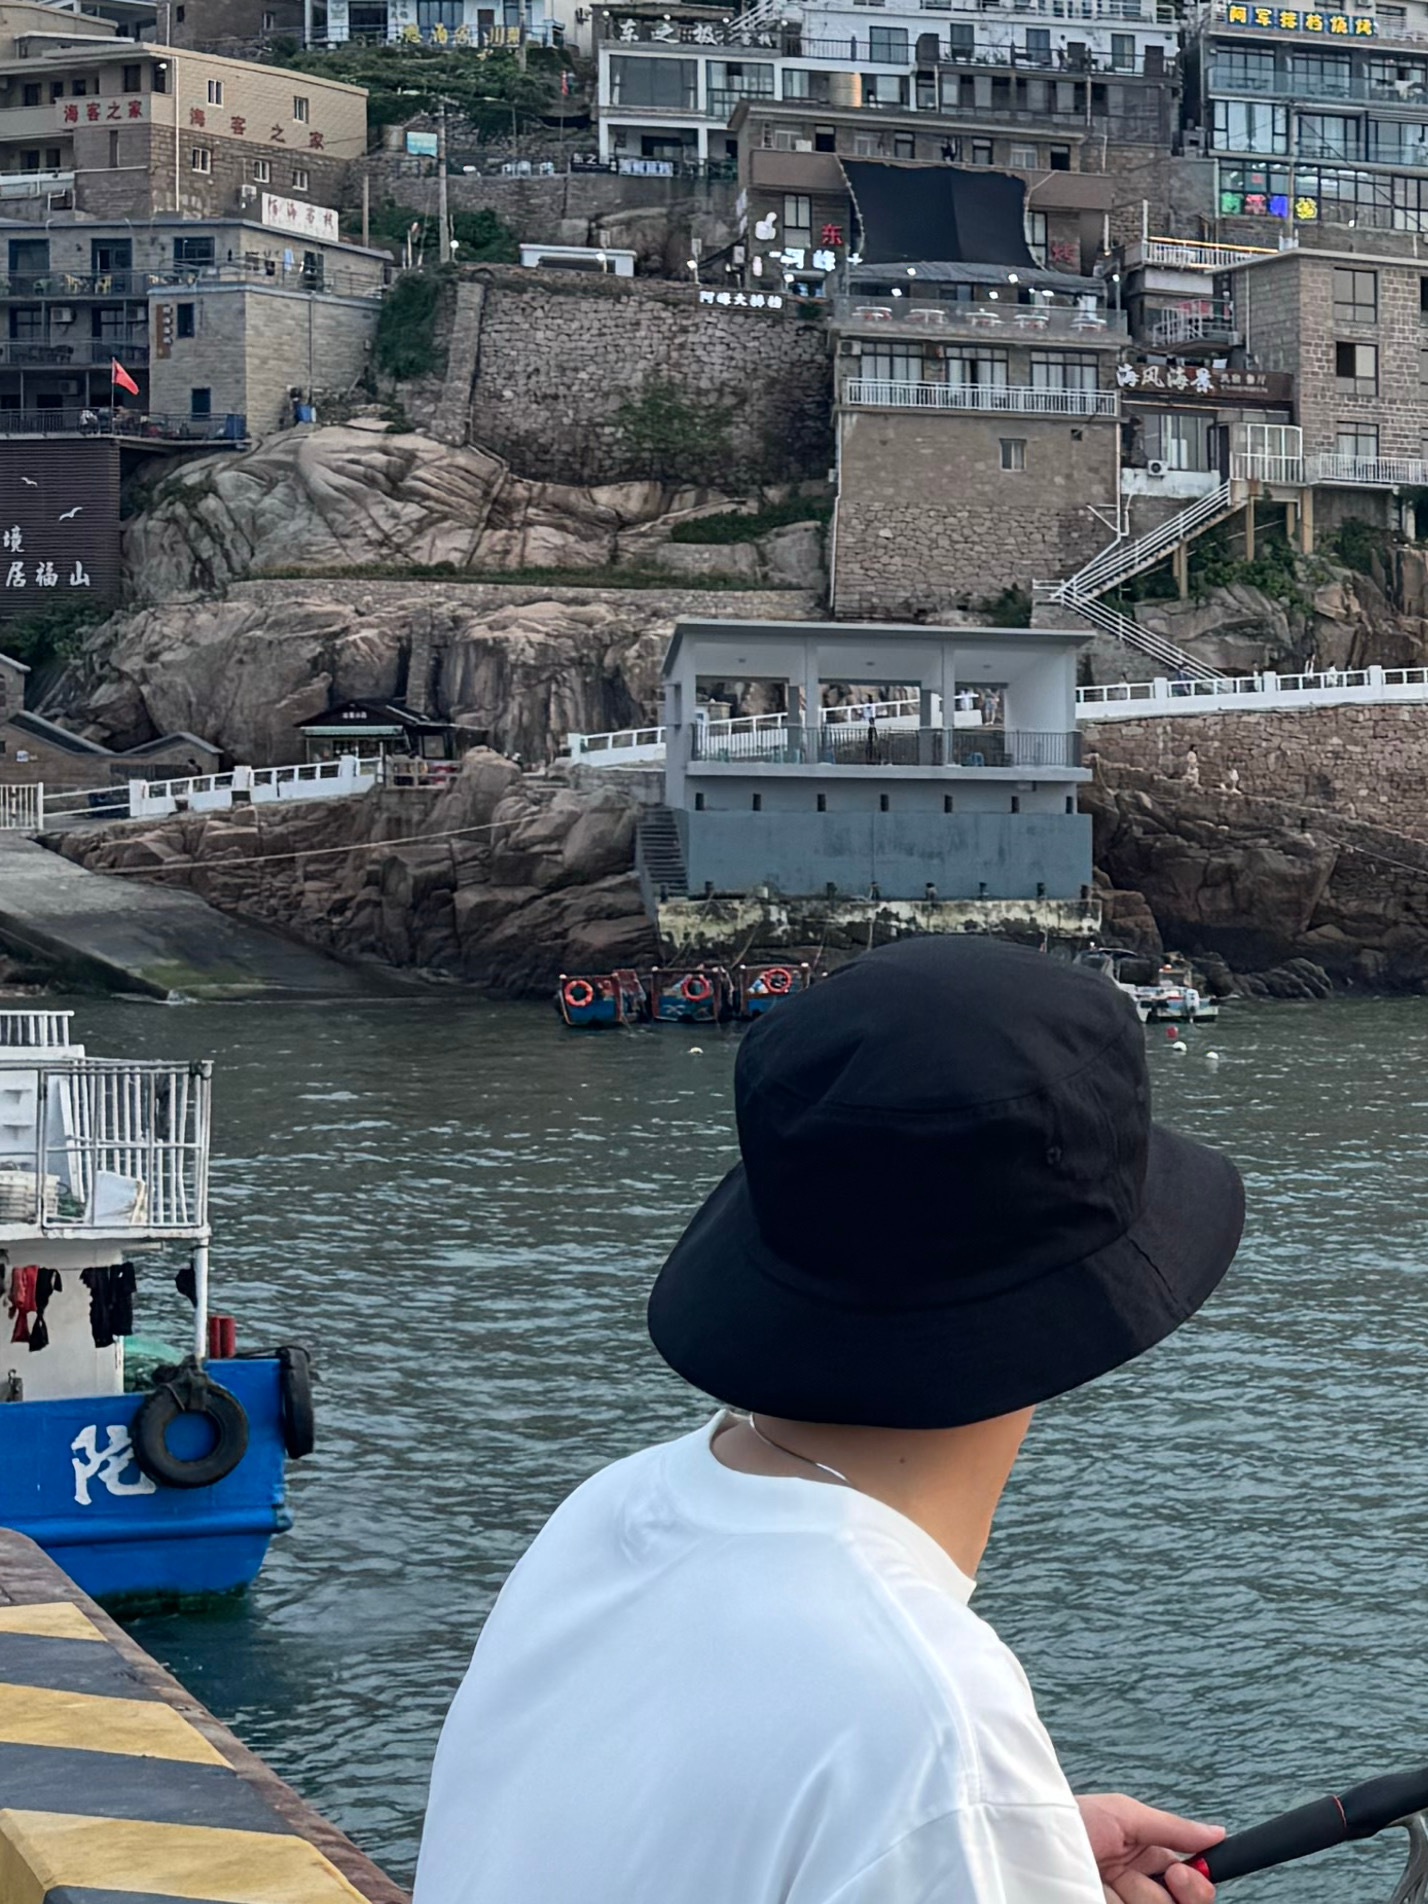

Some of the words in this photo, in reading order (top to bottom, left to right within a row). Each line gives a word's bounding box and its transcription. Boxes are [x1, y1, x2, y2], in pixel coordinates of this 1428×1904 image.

[64, 99, 142, 123] 海客之家
[190, 107, 324, 150] 海客之家
[1116, 363, 1214, 394] 海风海景
[5, 560, 91, 587] 居福山
